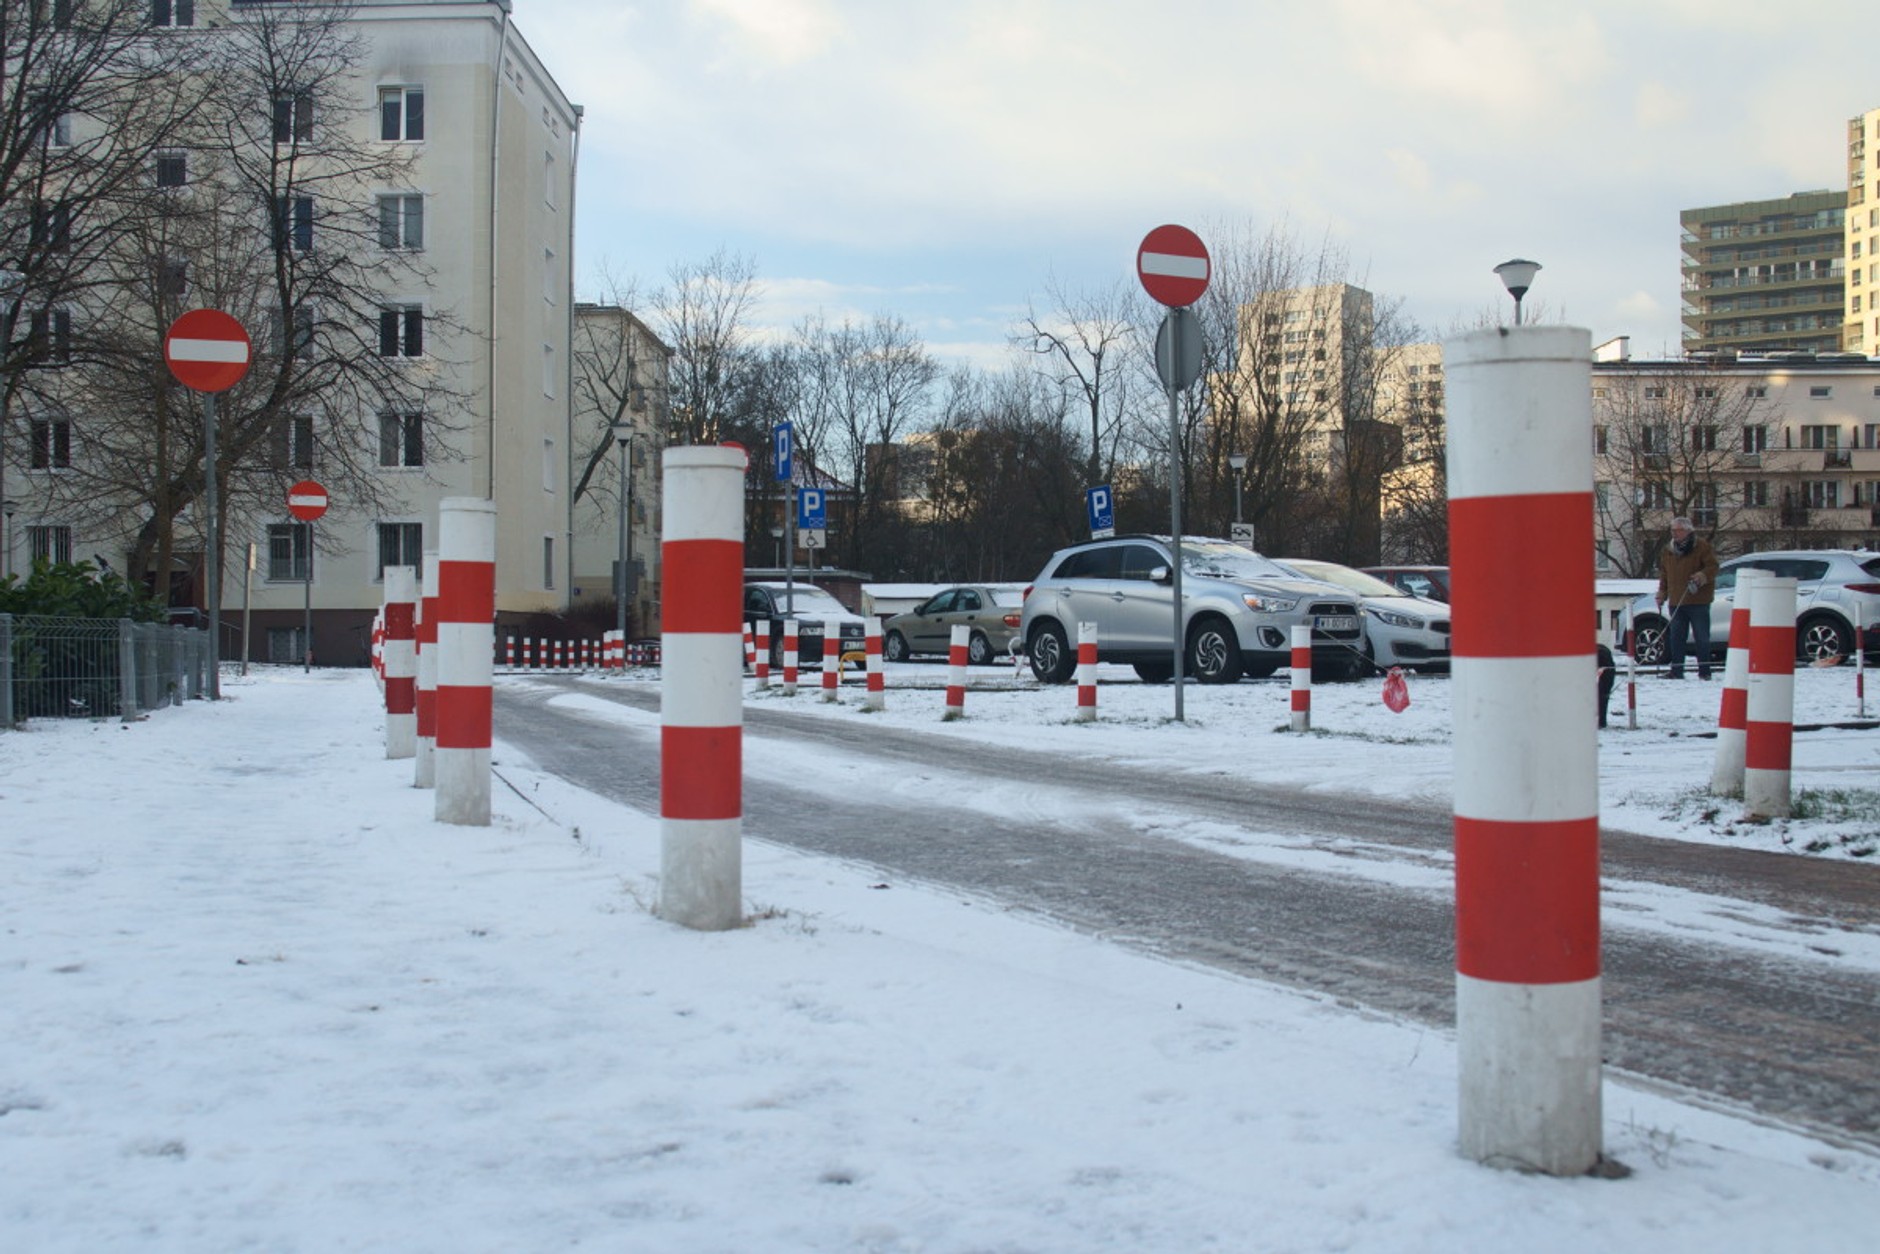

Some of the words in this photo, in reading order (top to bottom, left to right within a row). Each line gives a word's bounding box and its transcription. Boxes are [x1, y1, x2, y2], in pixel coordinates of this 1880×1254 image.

[778, 429, 788, 475] P
[804, 491, 820, 517] P
[1092, 490, 1107, 518] P
